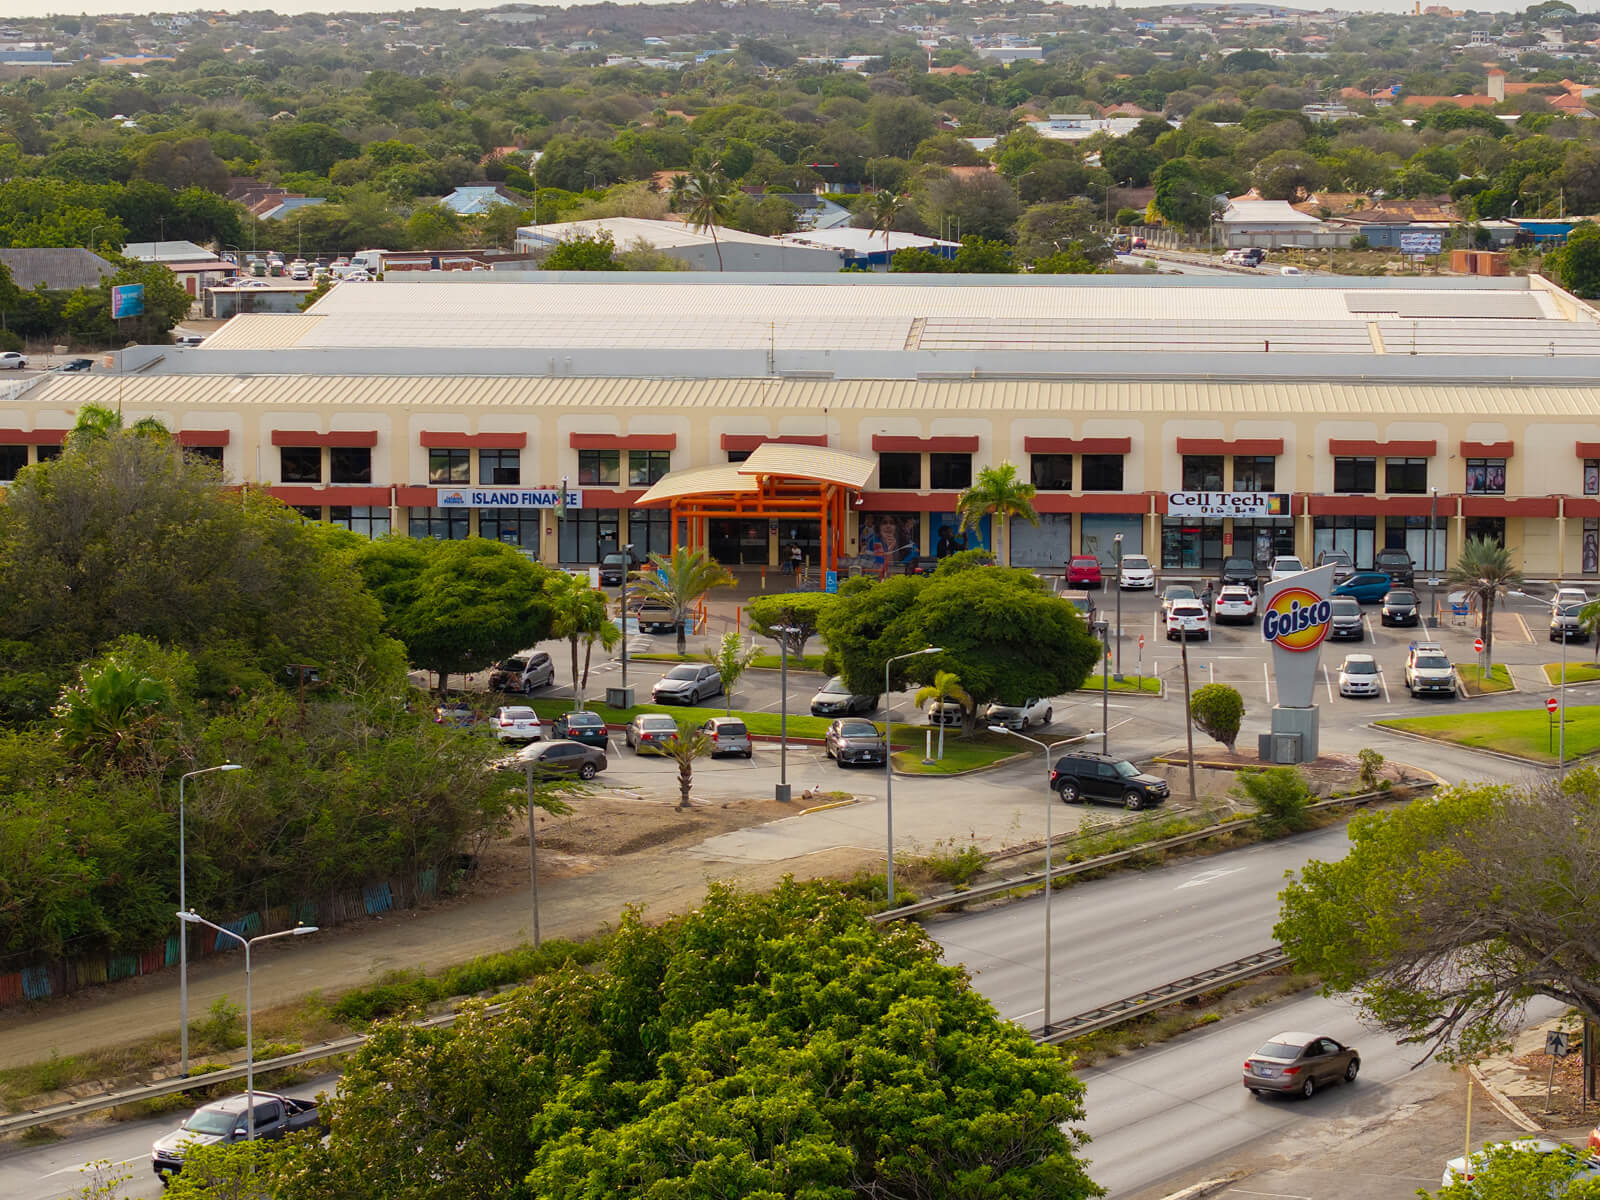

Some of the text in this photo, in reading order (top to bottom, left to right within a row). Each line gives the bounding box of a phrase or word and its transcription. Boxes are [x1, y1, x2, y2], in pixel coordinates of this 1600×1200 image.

[472, 492, 519, 505] ISLAND
[1169, 492, 1264, 506] Cell Tech
[1262, 600, 1332, 640] Goisco
